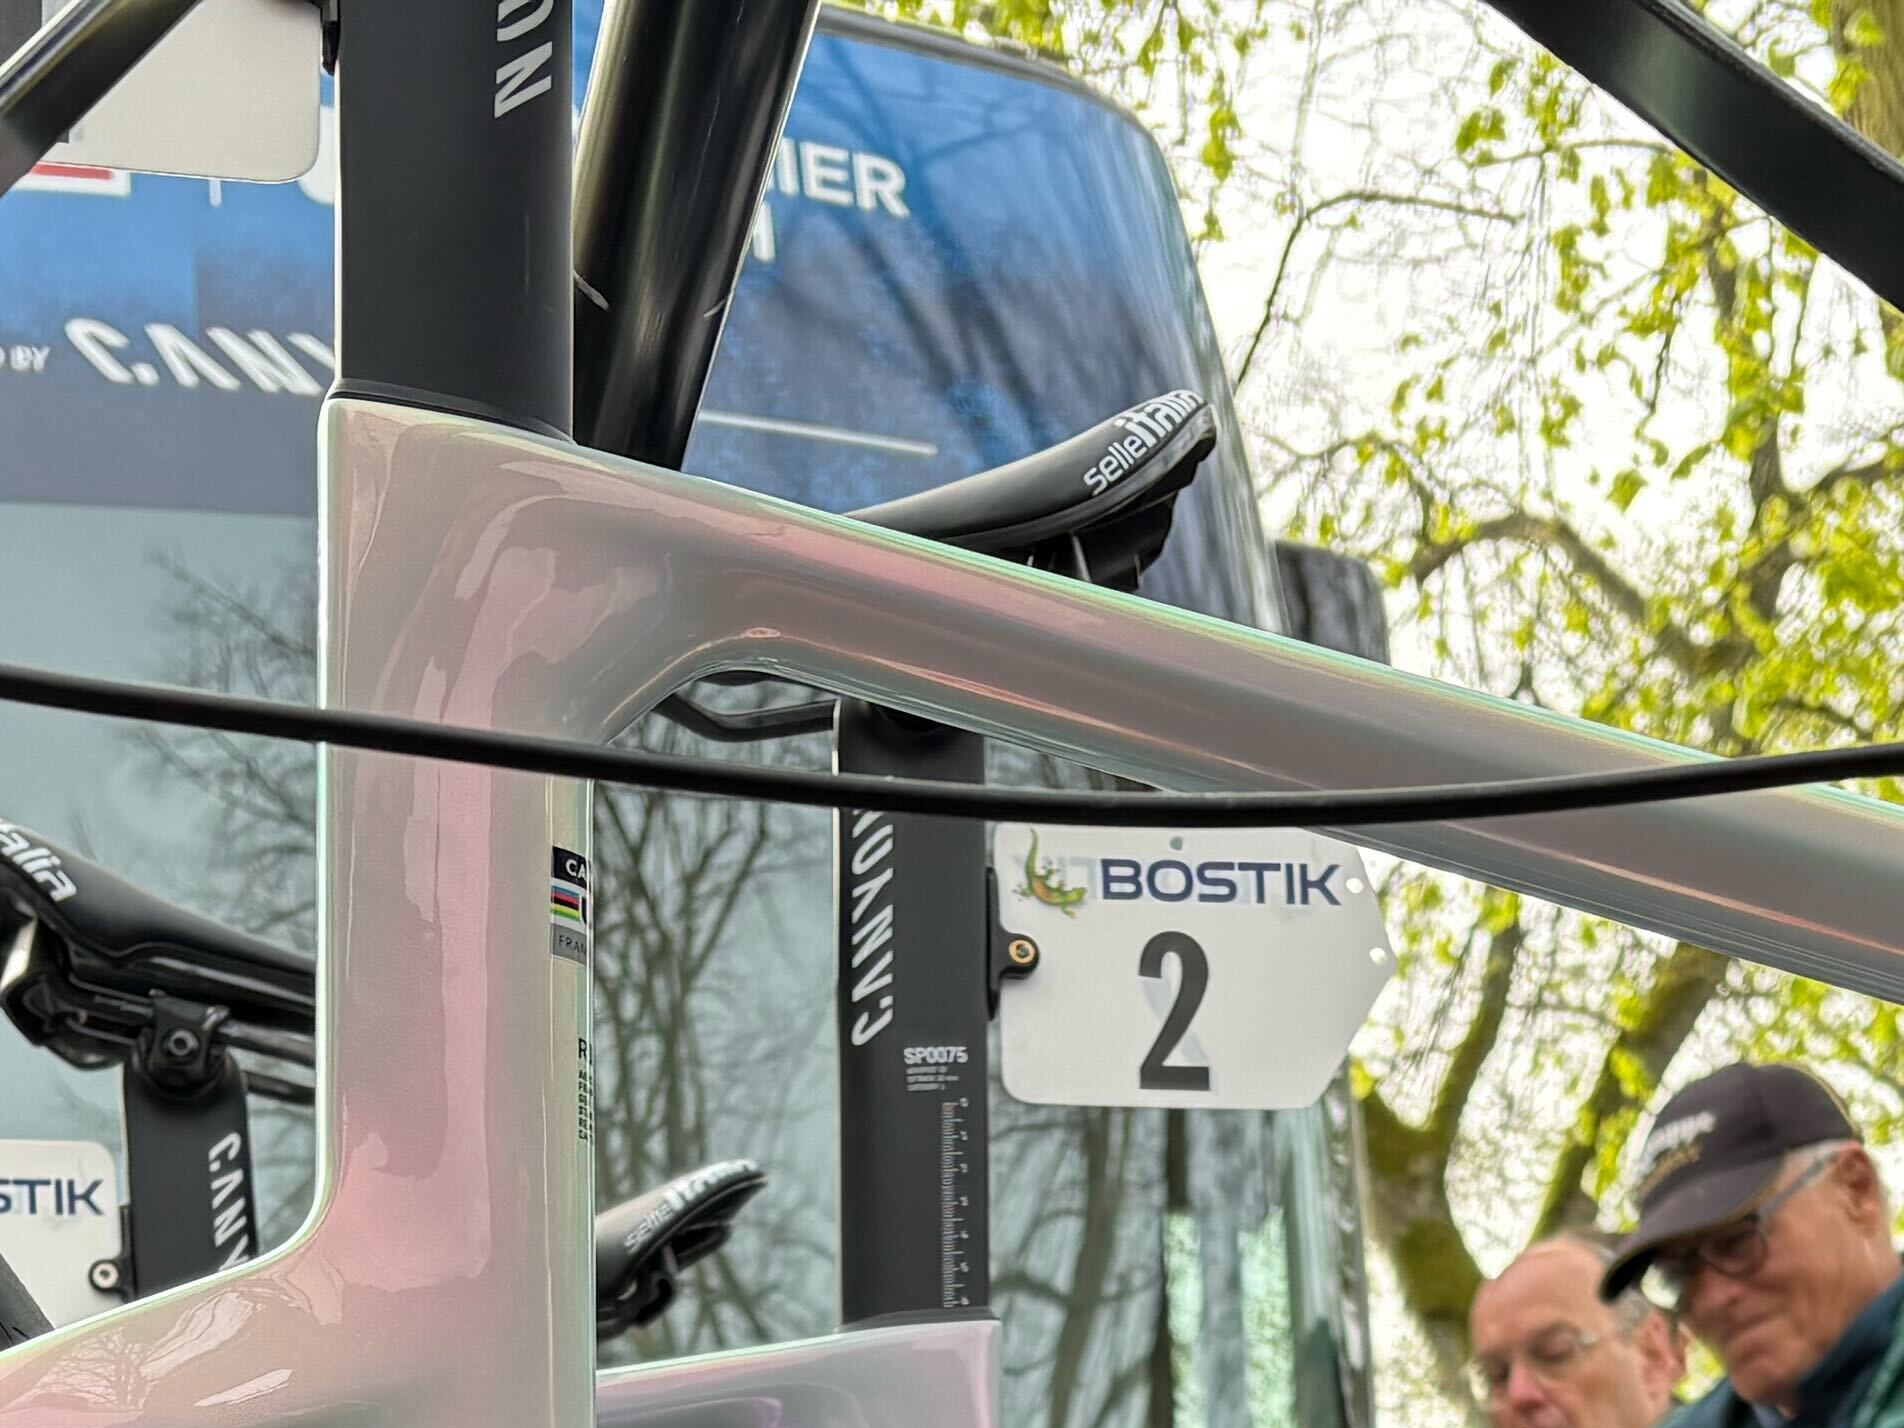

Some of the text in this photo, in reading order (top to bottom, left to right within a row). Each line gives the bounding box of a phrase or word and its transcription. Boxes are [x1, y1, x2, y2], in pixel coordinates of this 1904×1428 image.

[10, 346, 50, 372] BY
[1099, 857, 1342, 906] BOSTIK
[1138, 930, 1210, 1092] 2
